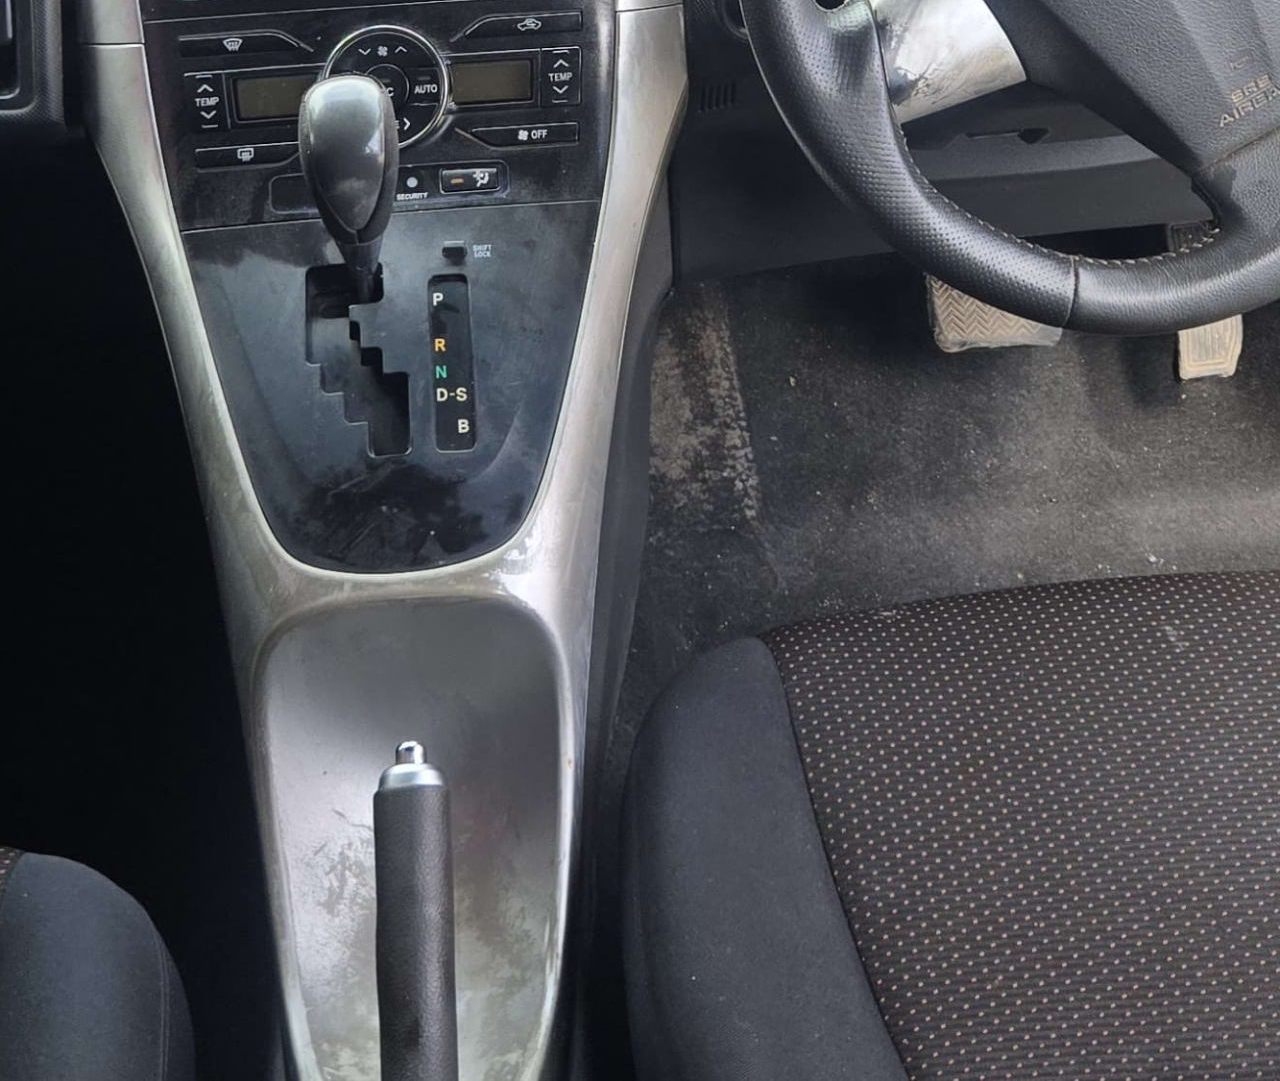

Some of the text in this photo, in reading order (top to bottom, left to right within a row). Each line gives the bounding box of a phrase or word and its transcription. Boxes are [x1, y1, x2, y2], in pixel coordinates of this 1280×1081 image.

[547, 71, 573, 82] TEMP
[414, 84, 438, 94] AUTO
[194, 96, 220, 107] TEMP
[531, 129, 548, 139] OFF
[396, 192, 429, 200] SECURITY
[432, 293, 444, 306] P
[434, 338, 446, 352] R
[435, 365, 447, 379] N
[436, 388, 468, 402] D-S
[458, 419, 470, 434] B
